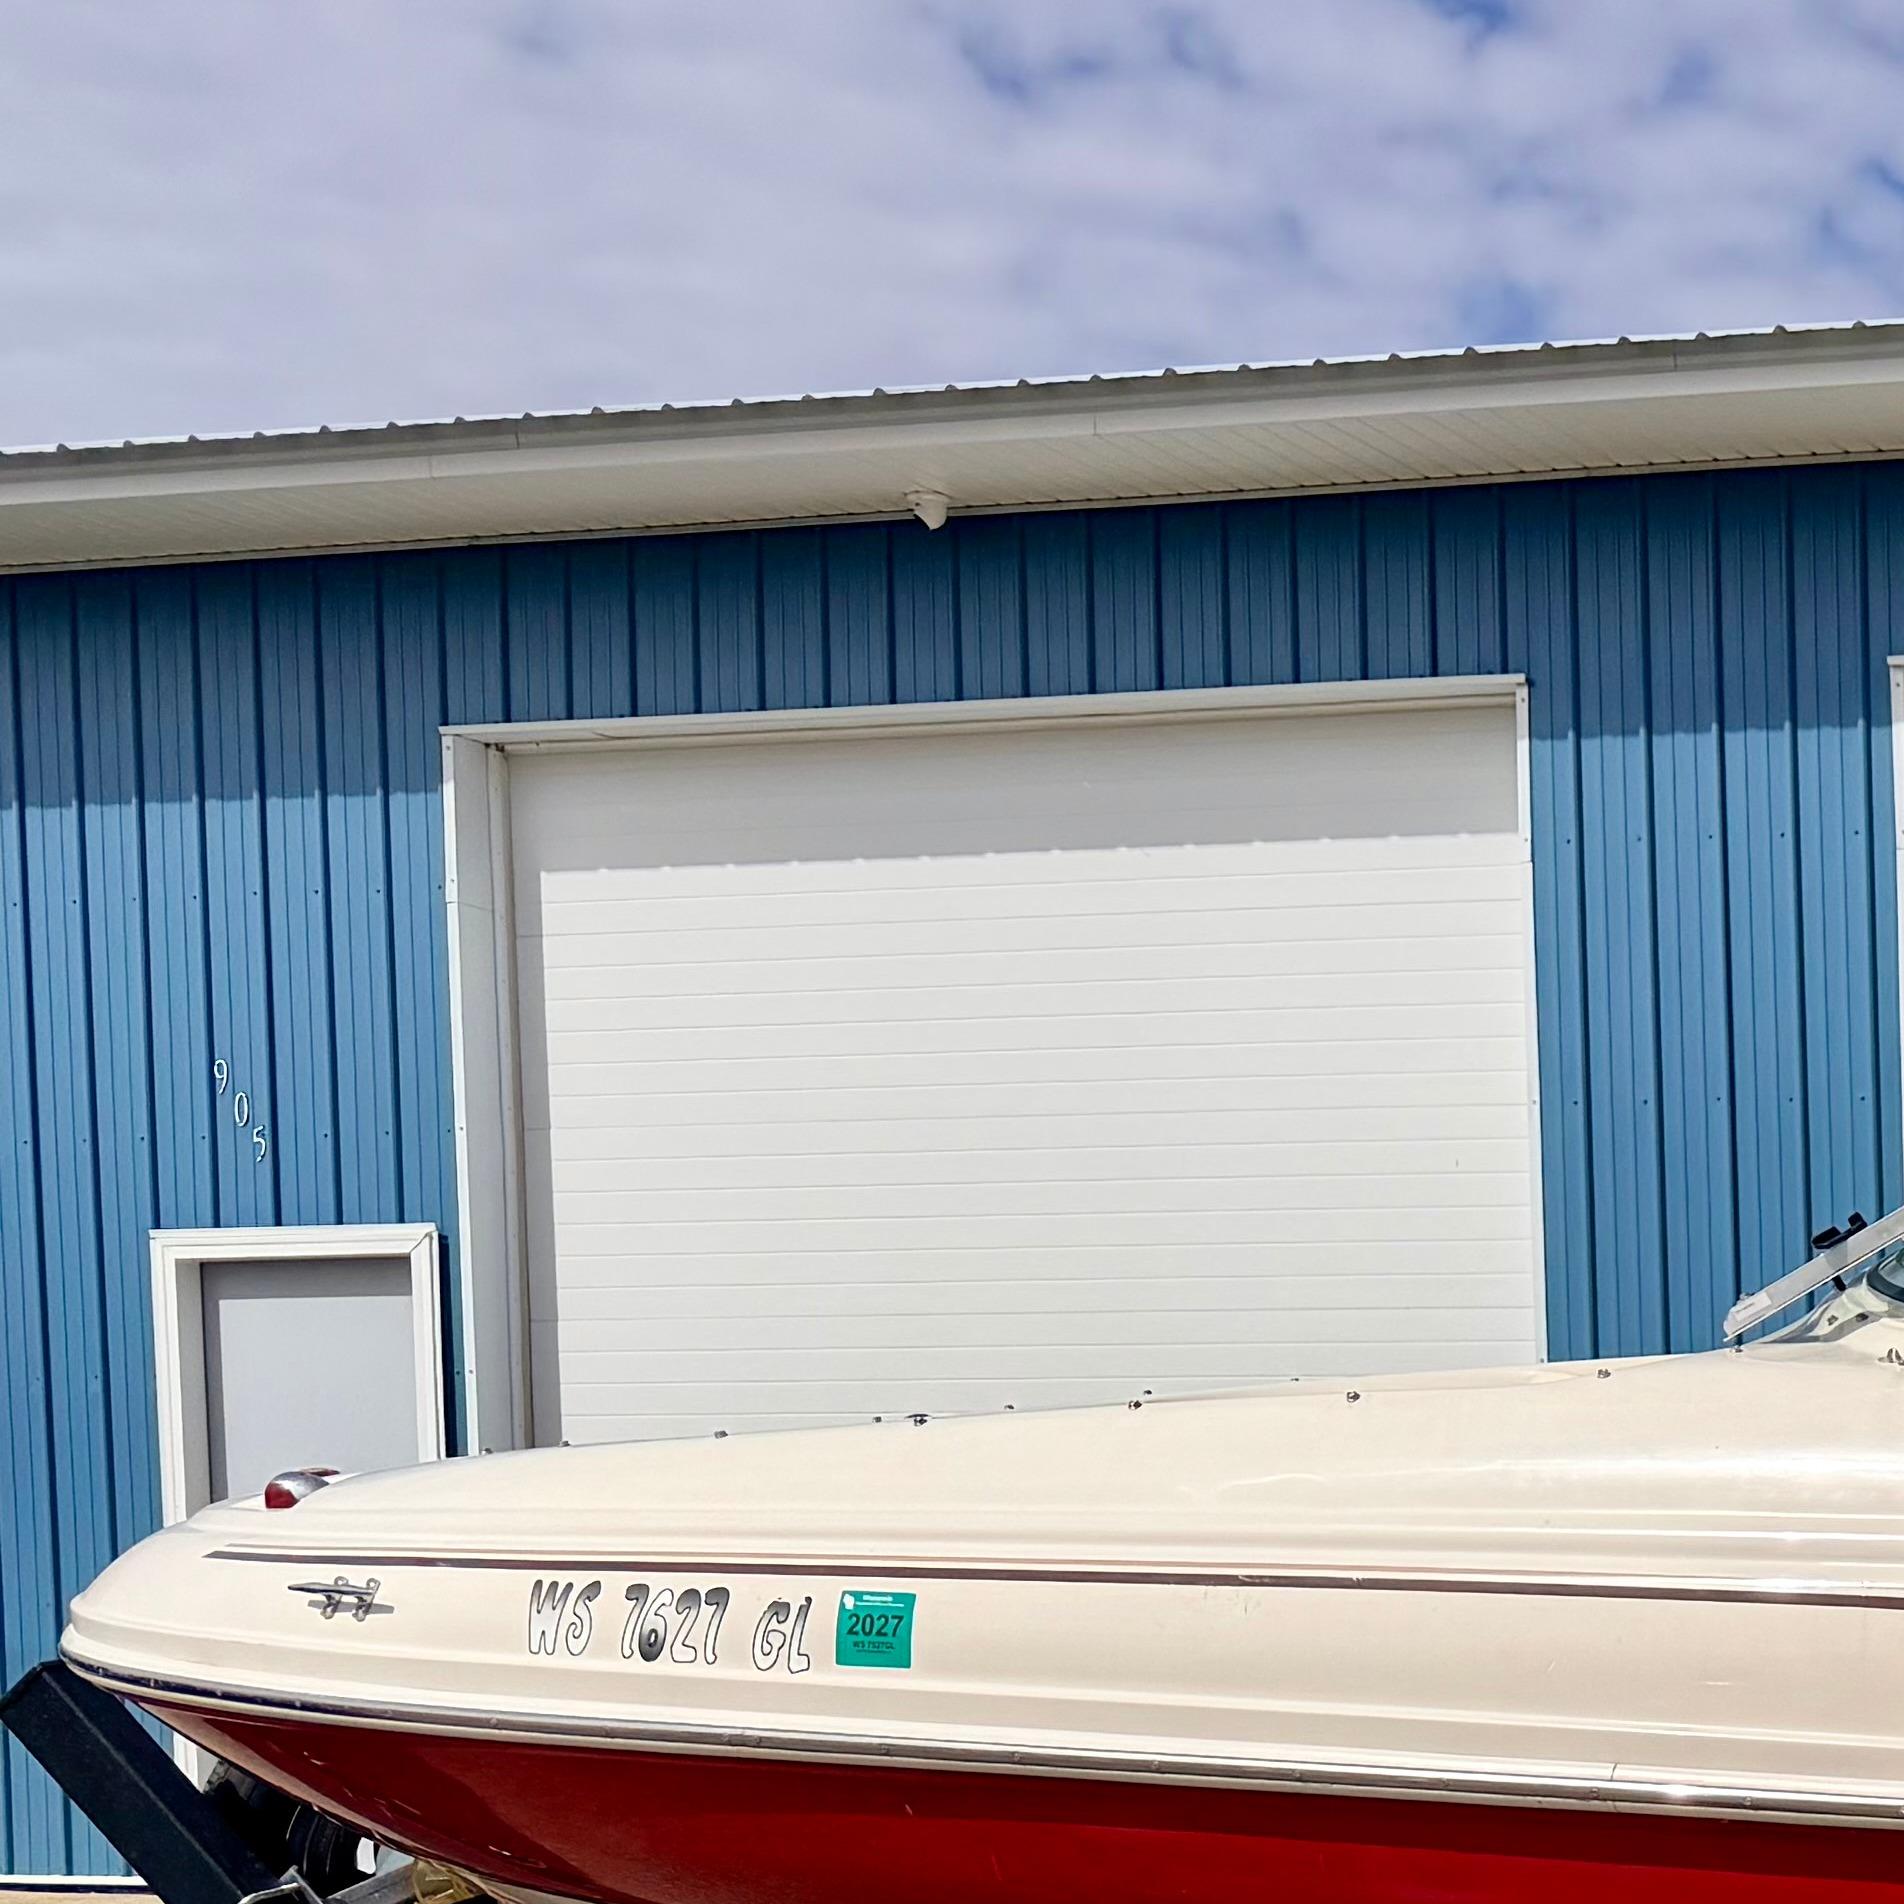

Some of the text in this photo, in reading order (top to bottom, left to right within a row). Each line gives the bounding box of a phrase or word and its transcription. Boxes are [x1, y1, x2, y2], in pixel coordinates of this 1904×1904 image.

[213, 1059, 267, 1162] 905
[529, 1579, 812, 1674] WS 7627 GL
[846, 1612, 905, 1638] 2027
